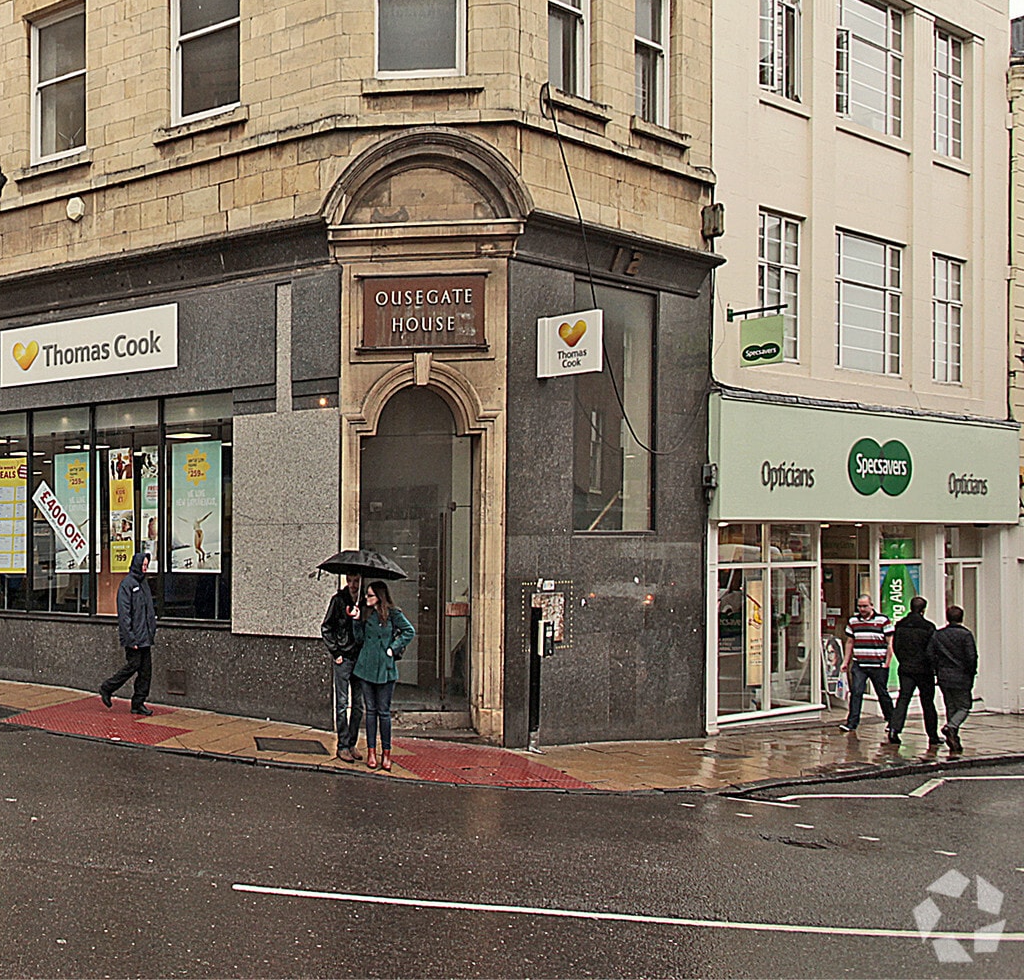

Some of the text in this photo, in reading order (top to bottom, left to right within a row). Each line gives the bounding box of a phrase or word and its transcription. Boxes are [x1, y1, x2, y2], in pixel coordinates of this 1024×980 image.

[375, 288, 472, 306] OUSEGATE
[392, 316, 455, 332] HOUSE
[42, 330, 161, 367] Thomas Cook
[557, 349, 587, 360] Thomas
[745, 346, 777, 357] Specsavers
[562, 358, 581, 368] Cook
[761, 460, 815, 493] Opticians
[855, 452, 908, 479] Specsavers
[947, 472, 989, 499] Opticians
[39, 490, 67, 526] £400
[64, 523, 87, 550] OFF
